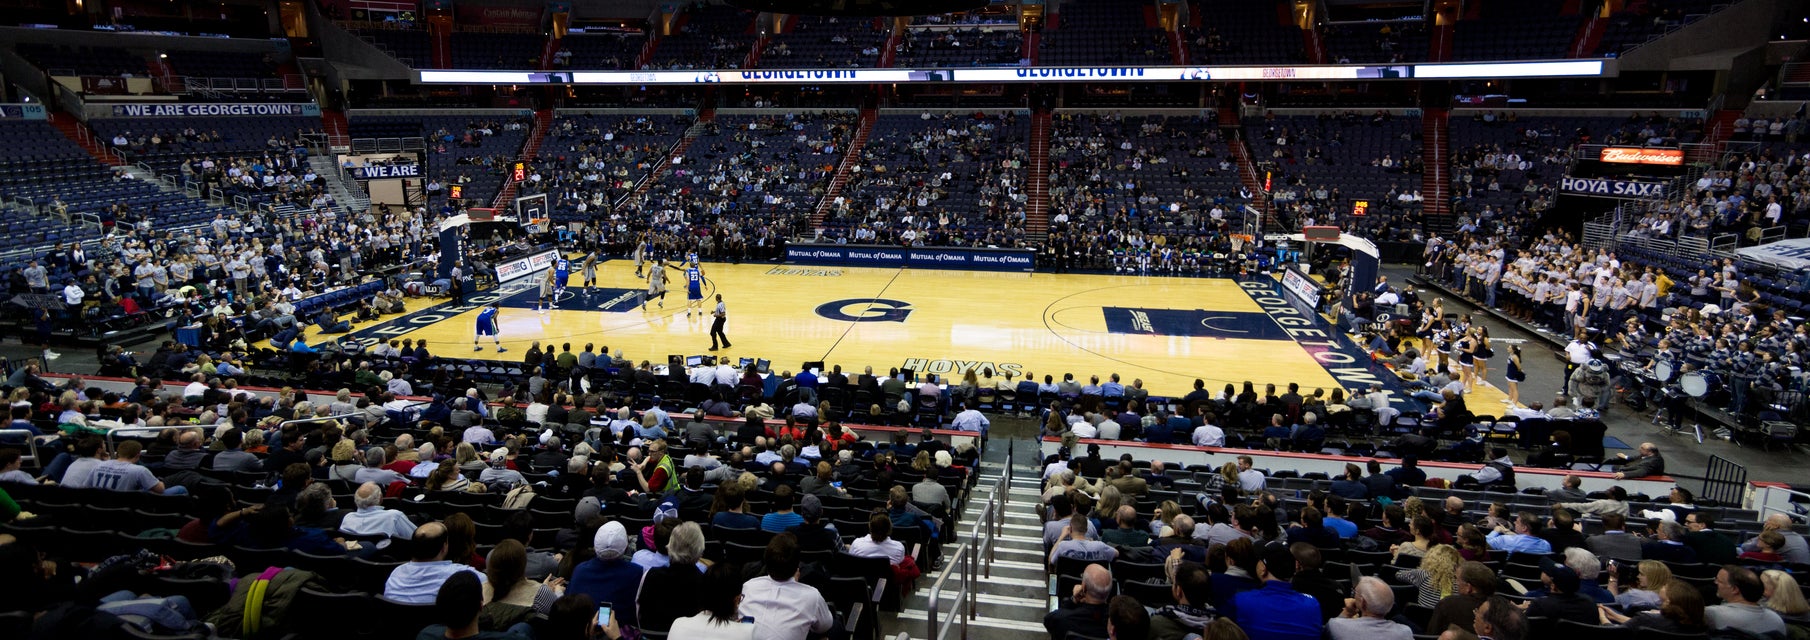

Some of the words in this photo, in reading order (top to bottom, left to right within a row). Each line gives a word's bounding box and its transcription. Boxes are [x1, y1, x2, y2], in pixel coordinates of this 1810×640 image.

[126, 105, 151, 116] WE
[155, 105, 184, 116] ARE
[187, 104, 292, 116] GEORGETOWN
[1602, 149, 1682, 163] Budweiser
[364, 166, 388, 178] WE
[391, 165, 418, 177] ARE
[1561, 178, 1609, 194] HOYA
[1613, 182, 1663, 197] SAXA
[812, 250, 819, 258] of
[873, 252, 880, 260] of
[936, 253, 943, 261] of
[999, 255, 1007, 264] of
[520, 261, 528, 271] G
[462, 274, 474, 283] PNC
[814, 298, 913, 323] G
[902, 358, 1023, 378] HOYAS
